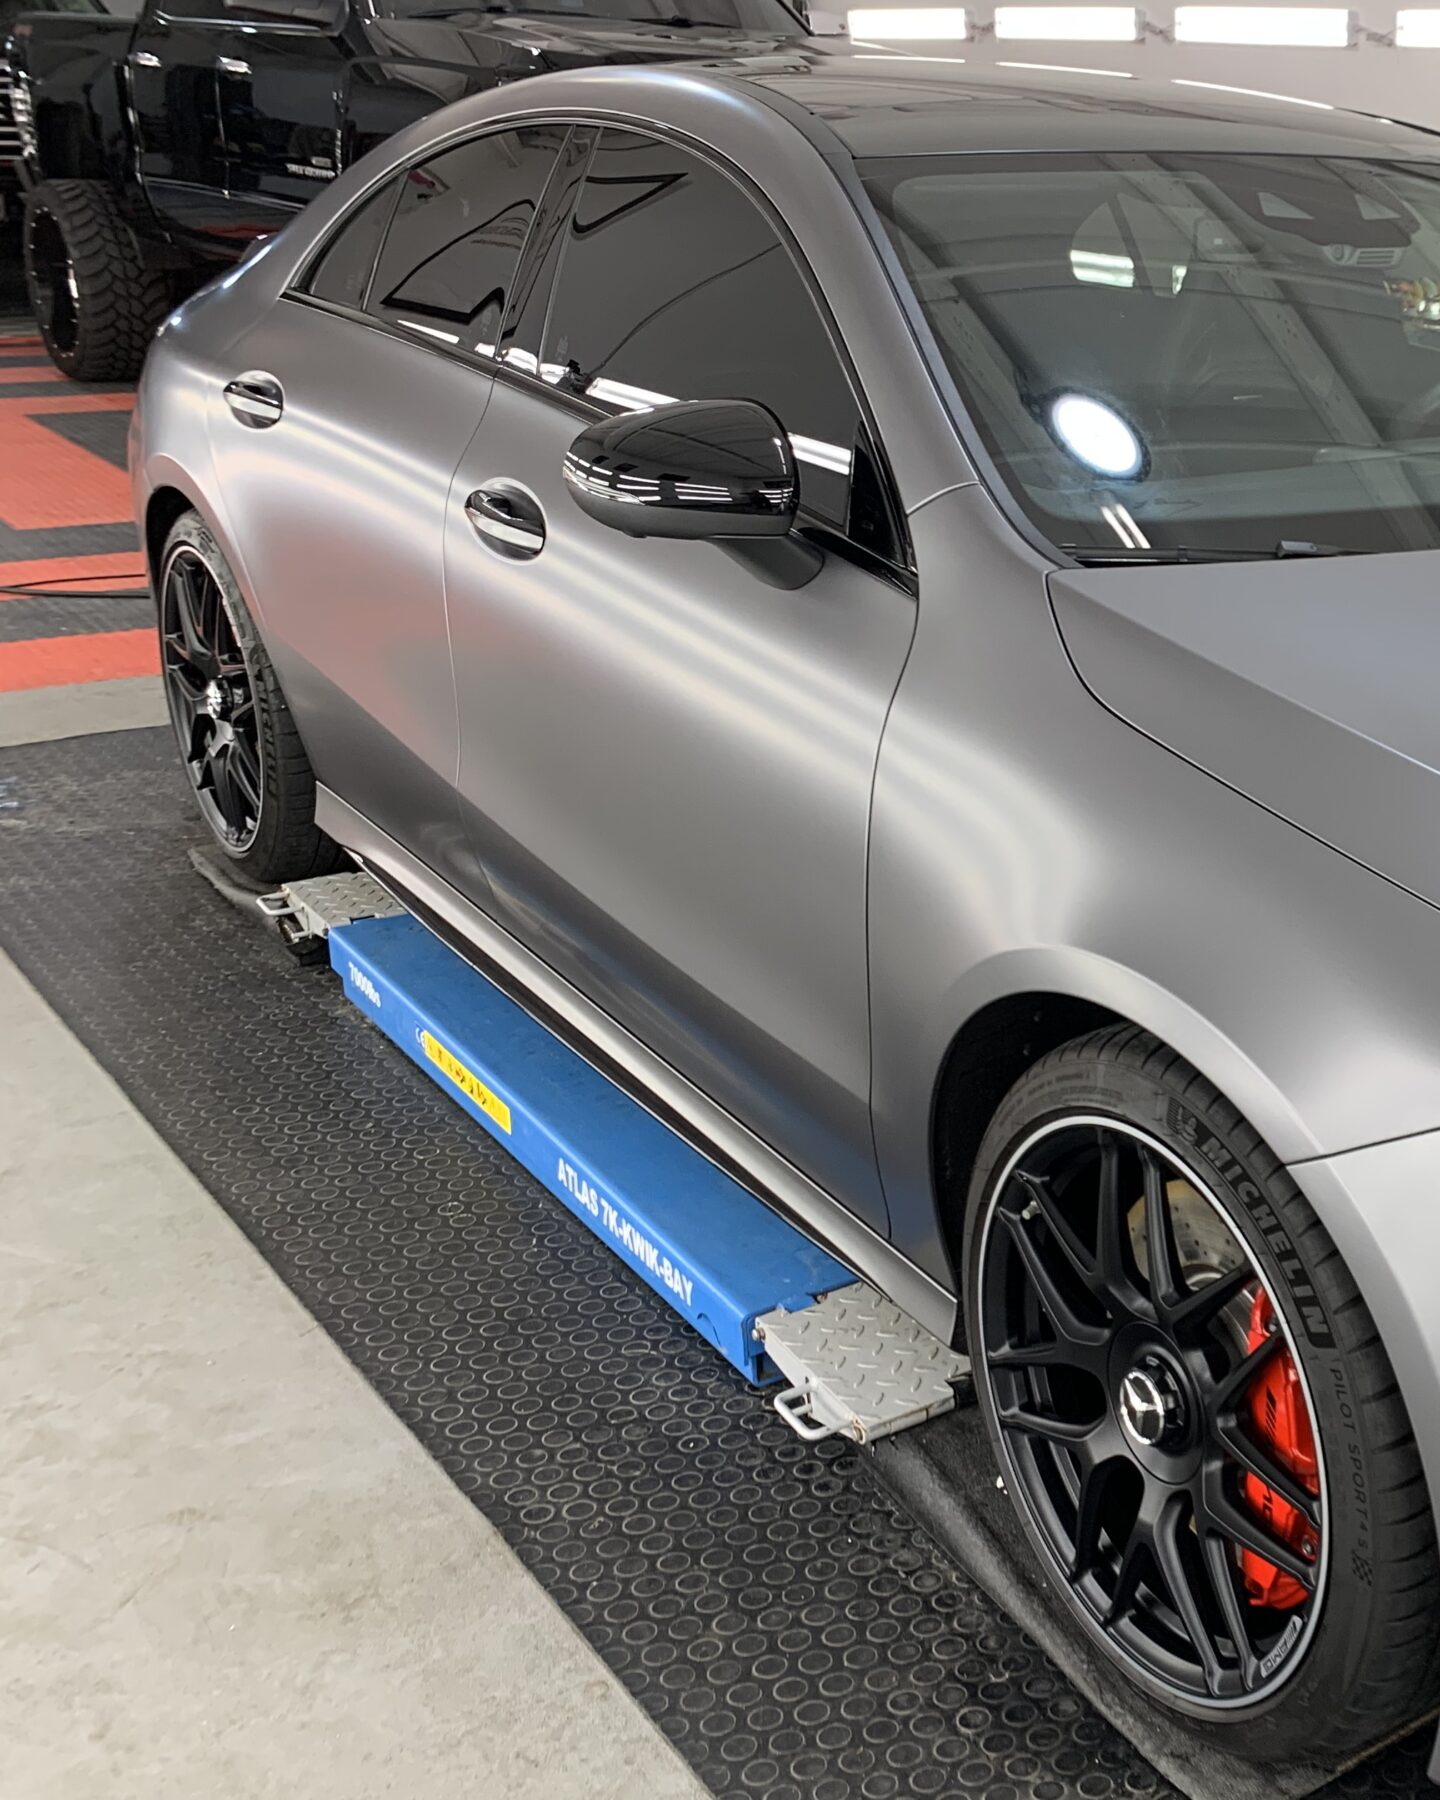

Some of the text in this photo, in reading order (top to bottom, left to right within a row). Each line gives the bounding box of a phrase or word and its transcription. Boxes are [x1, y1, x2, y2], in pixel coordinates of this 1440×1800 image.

[558, 1157, 693, 1307] ATLAS 7K-KWIK-BAY
[1201, 1136, 1330, 1333] MICHELIN
[1330, 1367, 1357, 1435] PILOT
[1348, 1442, 1369, 1523] SPORT
